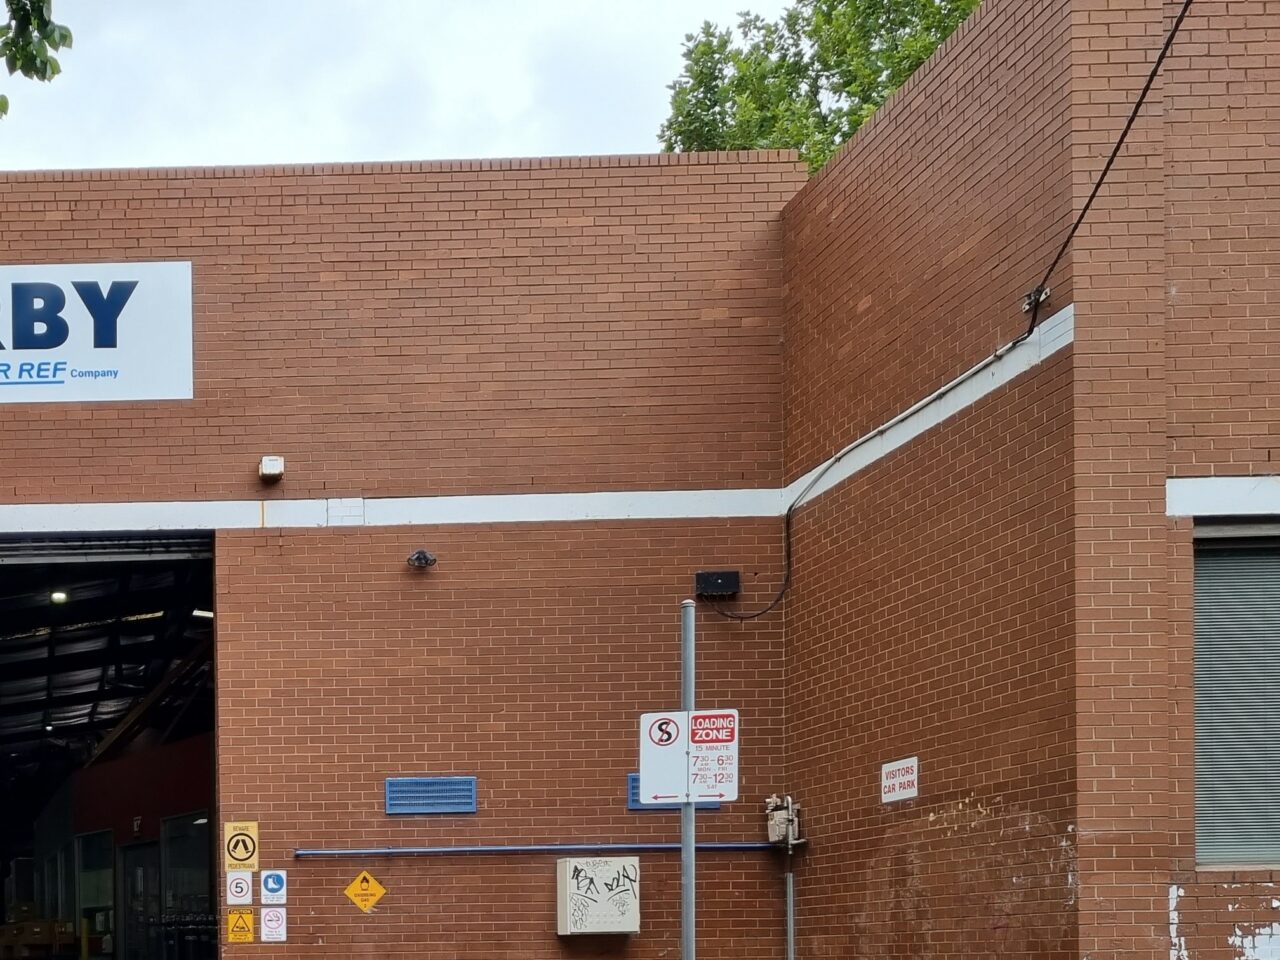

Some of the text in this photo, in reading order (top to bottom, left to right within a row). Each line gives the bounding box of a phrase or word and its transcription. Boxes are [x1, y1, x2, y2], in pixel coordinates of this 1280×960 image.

[18, 361, 67, 379] REF
[70, 368, 119, 380] Company
[692, 718, 734, 729] LOADING
[694, 729, 732, 740] ZONE
[885, 765, 914, 780] VISITORS
[883, 779, 916, 794] CAR PARK
[234, 882, 244, 894] 5
